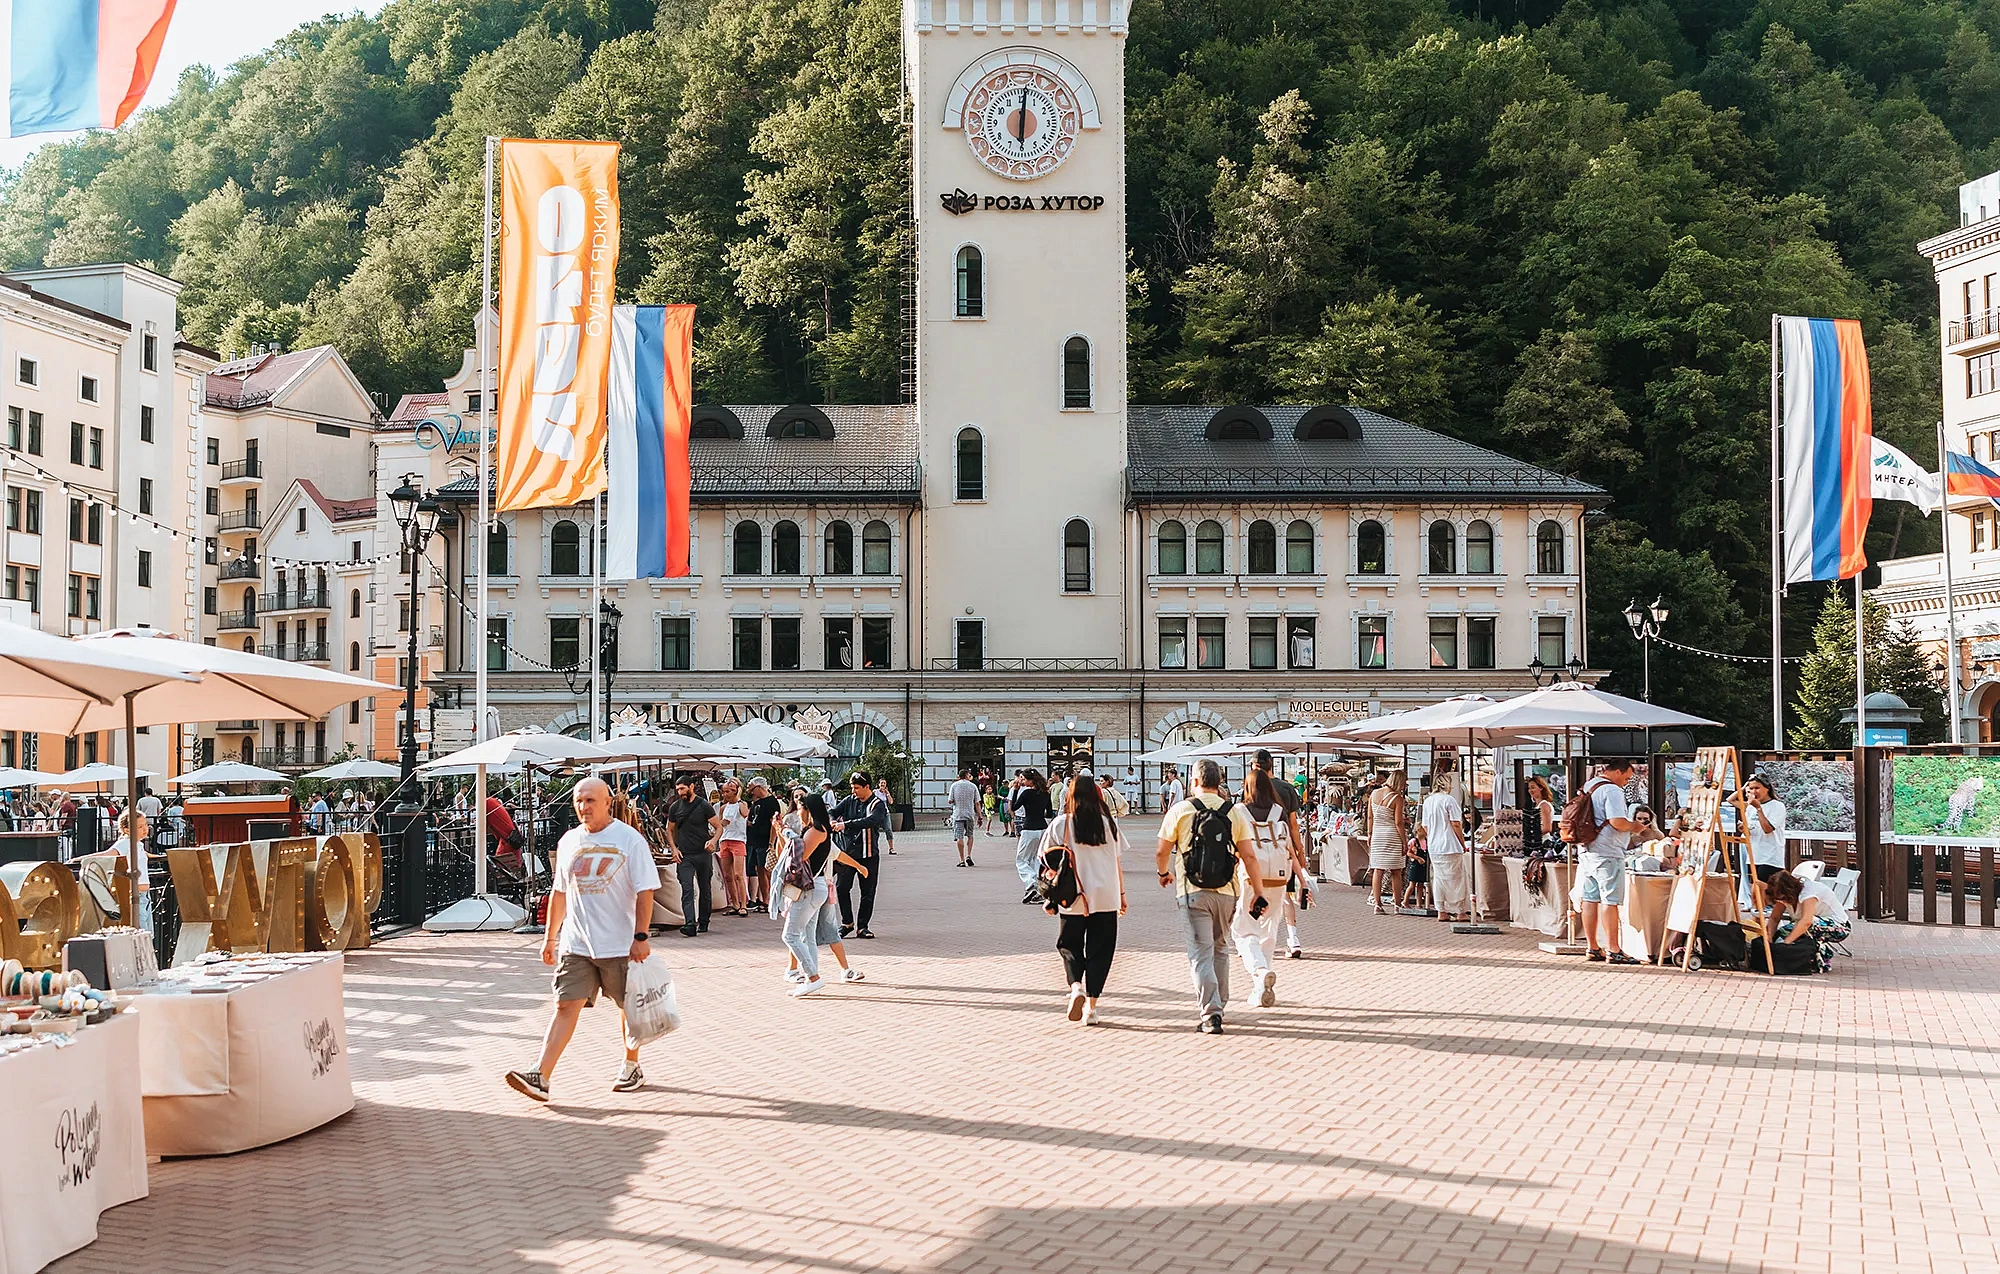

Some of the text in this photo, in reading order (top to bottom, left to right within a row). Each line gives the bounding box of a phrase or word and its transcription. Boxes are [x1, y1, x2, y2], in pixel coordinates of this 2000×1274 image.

[984, 195, 1105, 211] РОЗА ХУТОР
[591, 188, 610, 261] ярким
[1875, 473, 1918, 488] ИНТЕР
[655, 703, 786, 724] LUCIANO
[1290, 701, 1369, 712] MOLECULE
